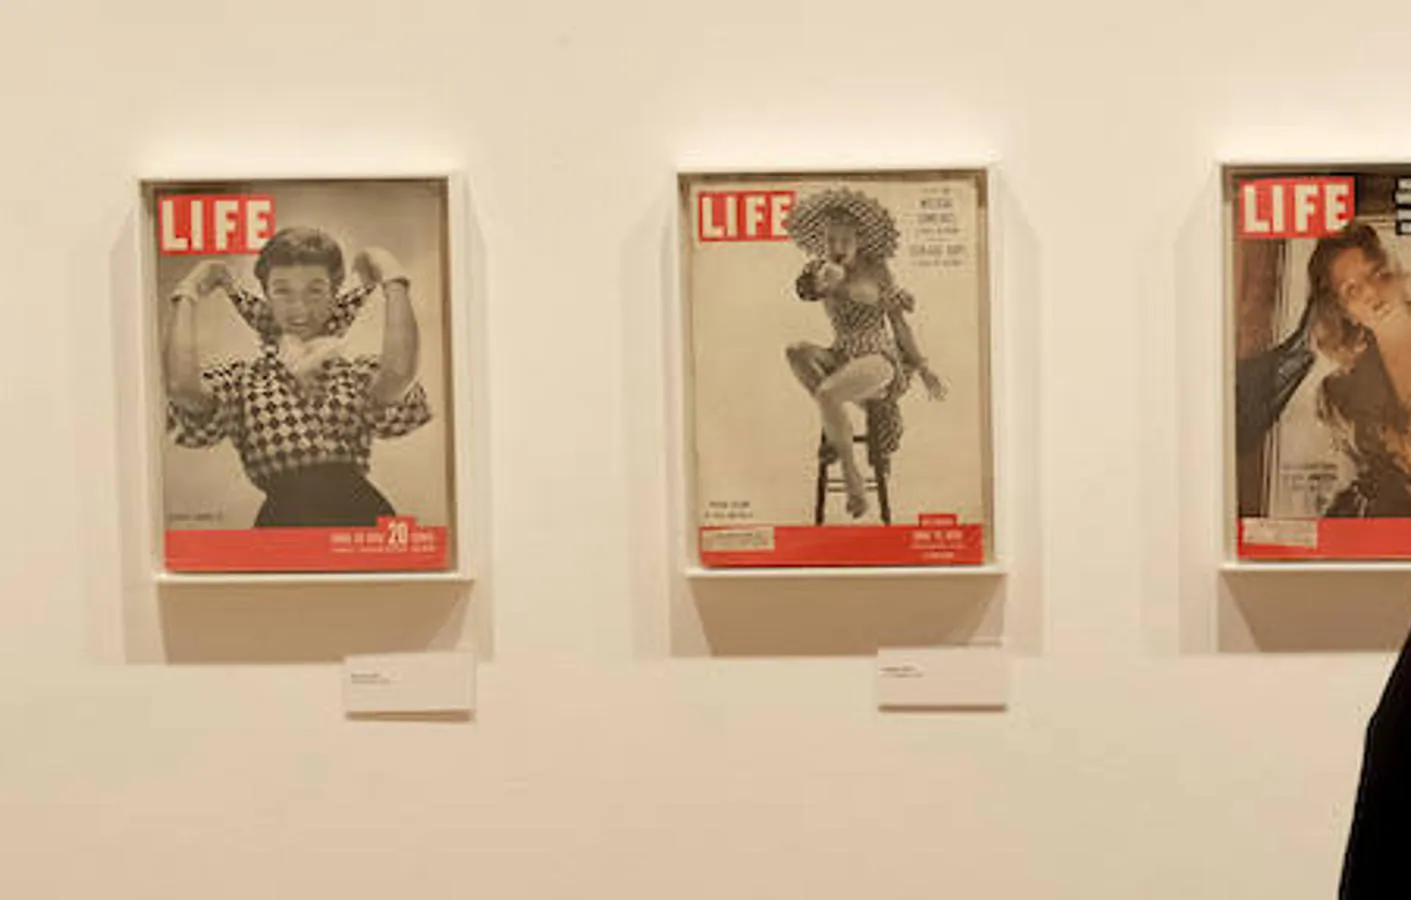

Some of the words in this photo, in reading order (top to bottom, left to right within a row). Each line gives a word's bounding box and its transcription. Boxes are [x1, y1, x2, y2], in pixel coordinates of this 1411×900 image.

[162, 199, 271, 251] LIFE
[702, 194, 793, 239] LIFE
[1243, 184, 1350, 232] LIFE
[387, 520, 409, 547] 20
